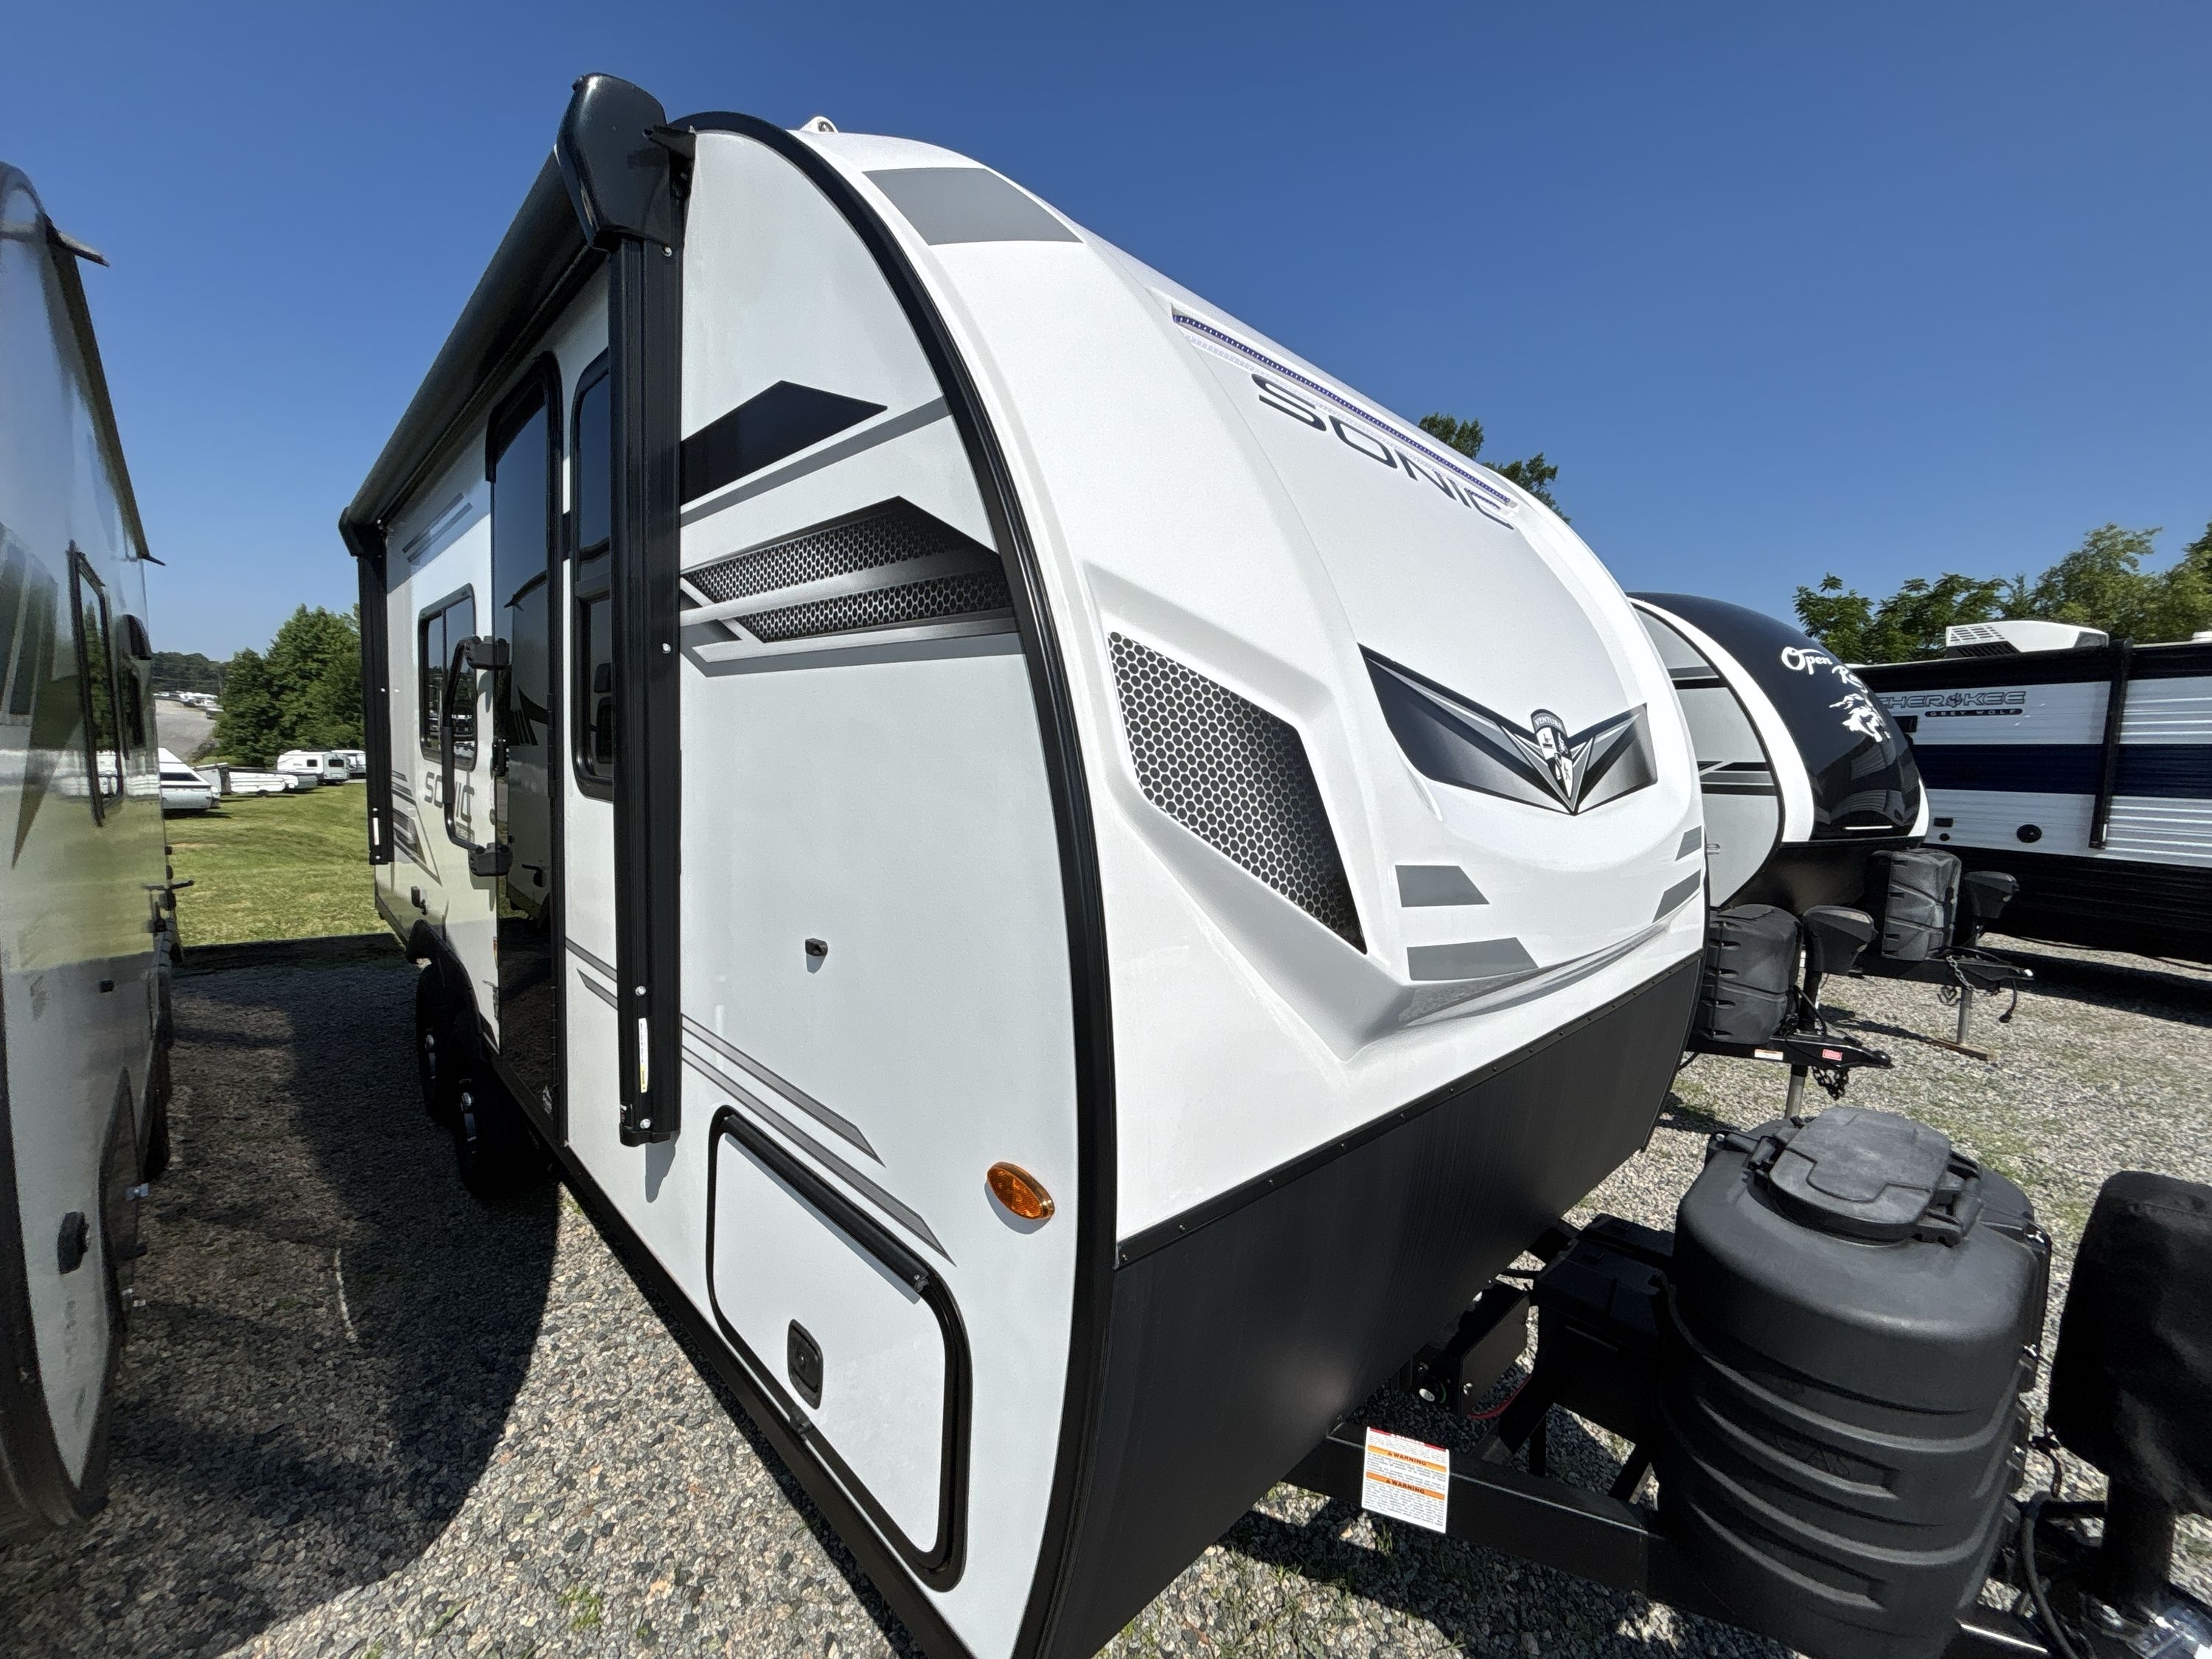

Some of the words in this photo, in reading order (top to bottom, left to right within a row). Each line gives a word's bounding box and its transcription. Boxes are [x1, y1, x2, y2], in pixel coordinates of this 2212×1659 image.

[1251, 372, 1514, 529] SONIC
[1781, 647, 1833, 675] Open
[1534, 716, 1563, 731] VENTURE
[424, 771, 475, 823] SOIC
[1393, 1453, 1427, 1466] WARNING
[1391, 1479, 1425, 1494] WARNING
